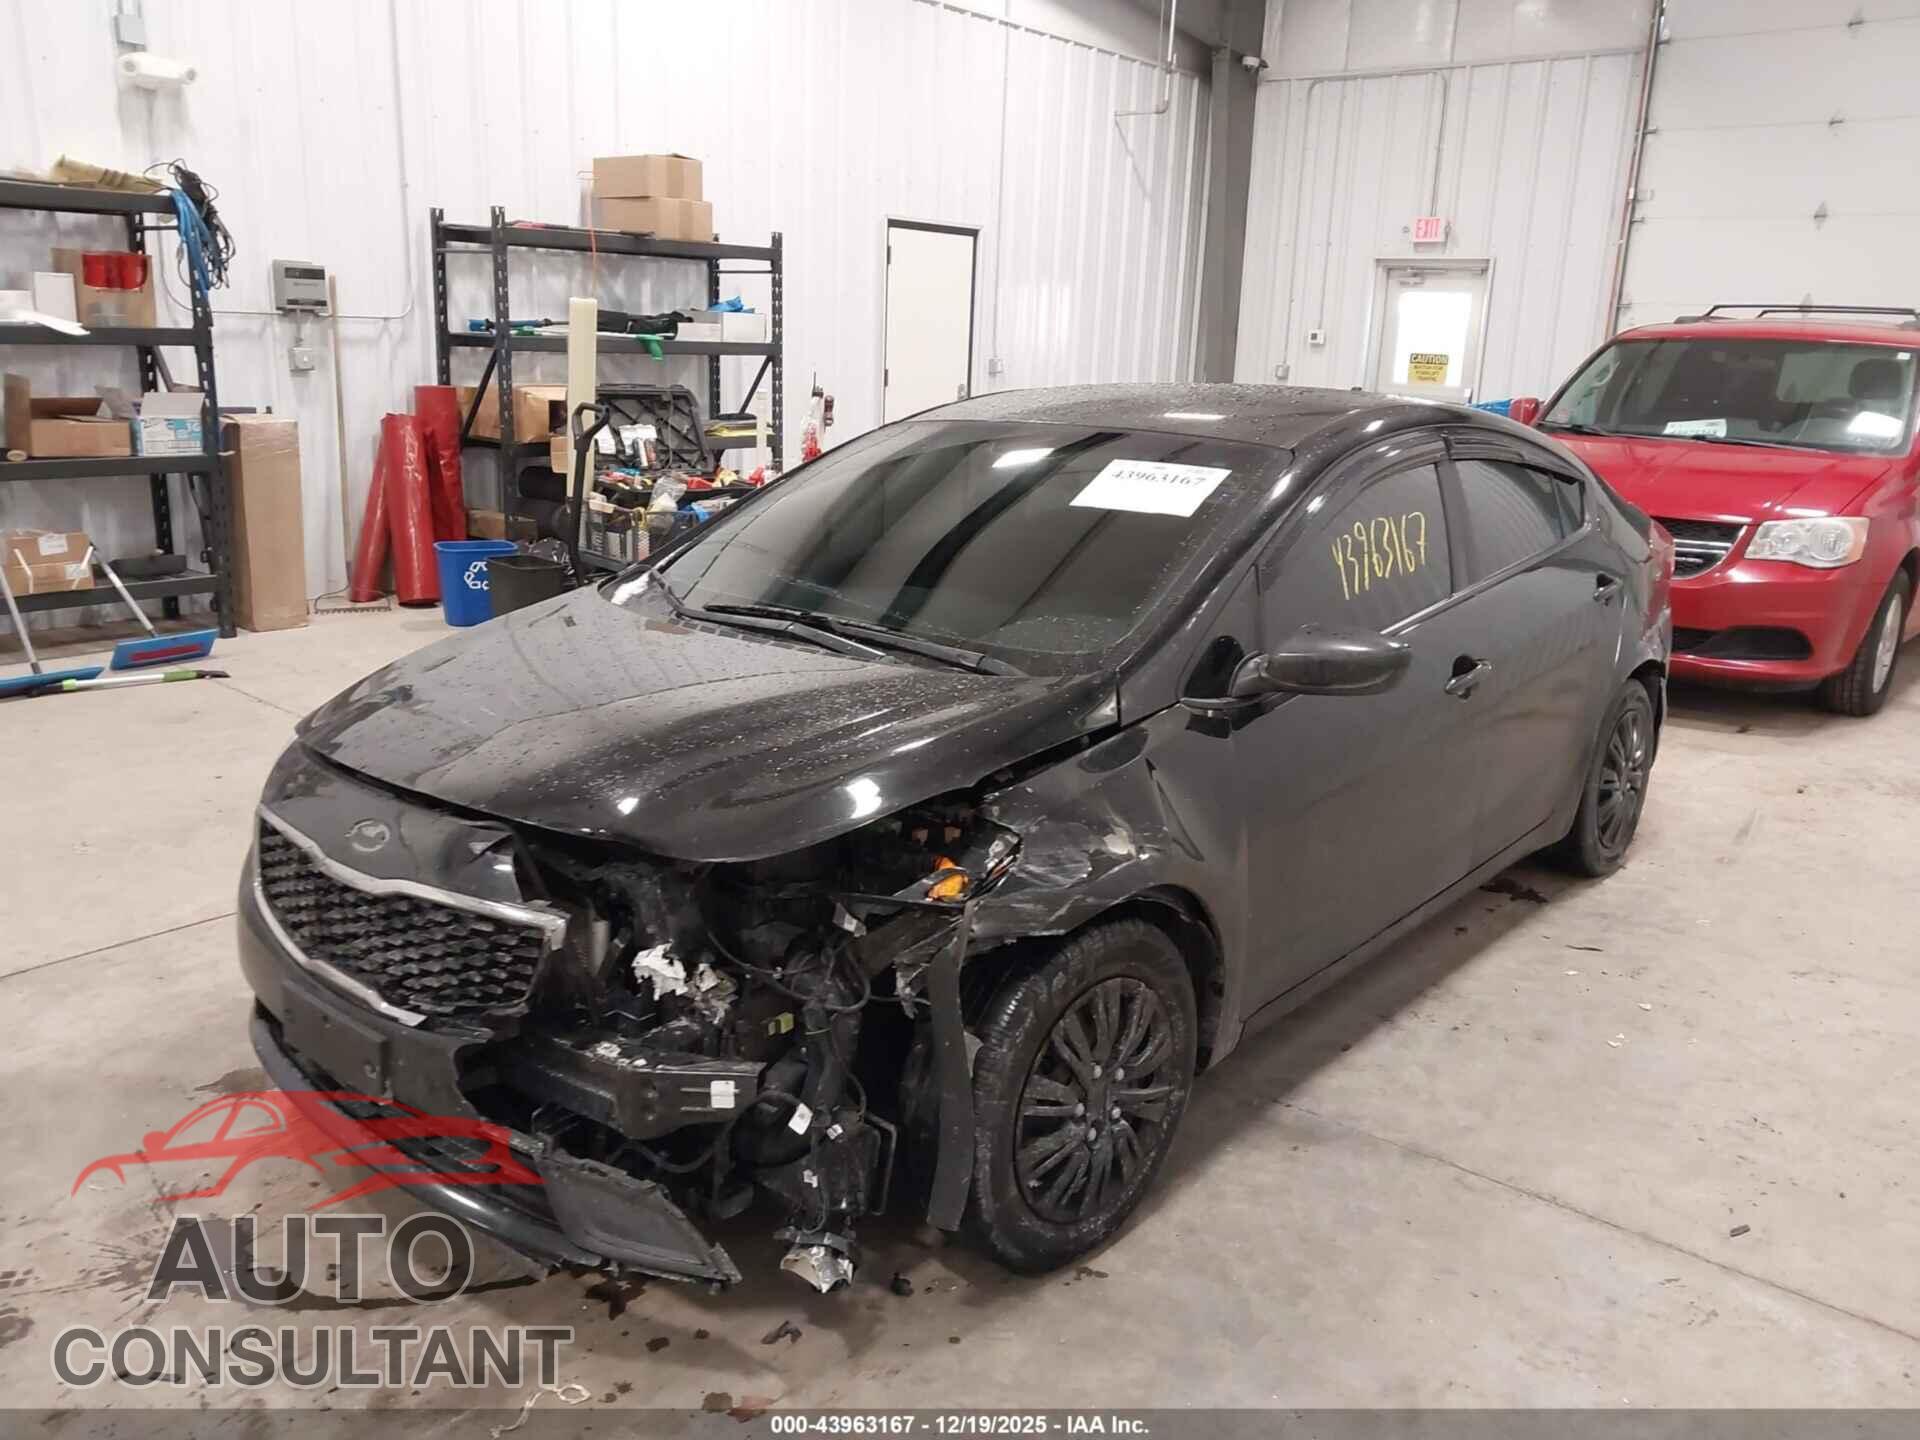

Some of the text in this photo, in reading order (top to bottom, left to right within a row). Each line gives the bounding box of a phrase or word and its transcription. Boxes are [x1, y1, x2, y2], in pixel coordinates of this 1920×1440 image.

[1415, 218, 1441, 239] EXIT
[1410, 354, 1448, 364] CAUTION
[1111, 469, 1207, 487] 43963167
[1331, 511, 1426, 601] 43963167
